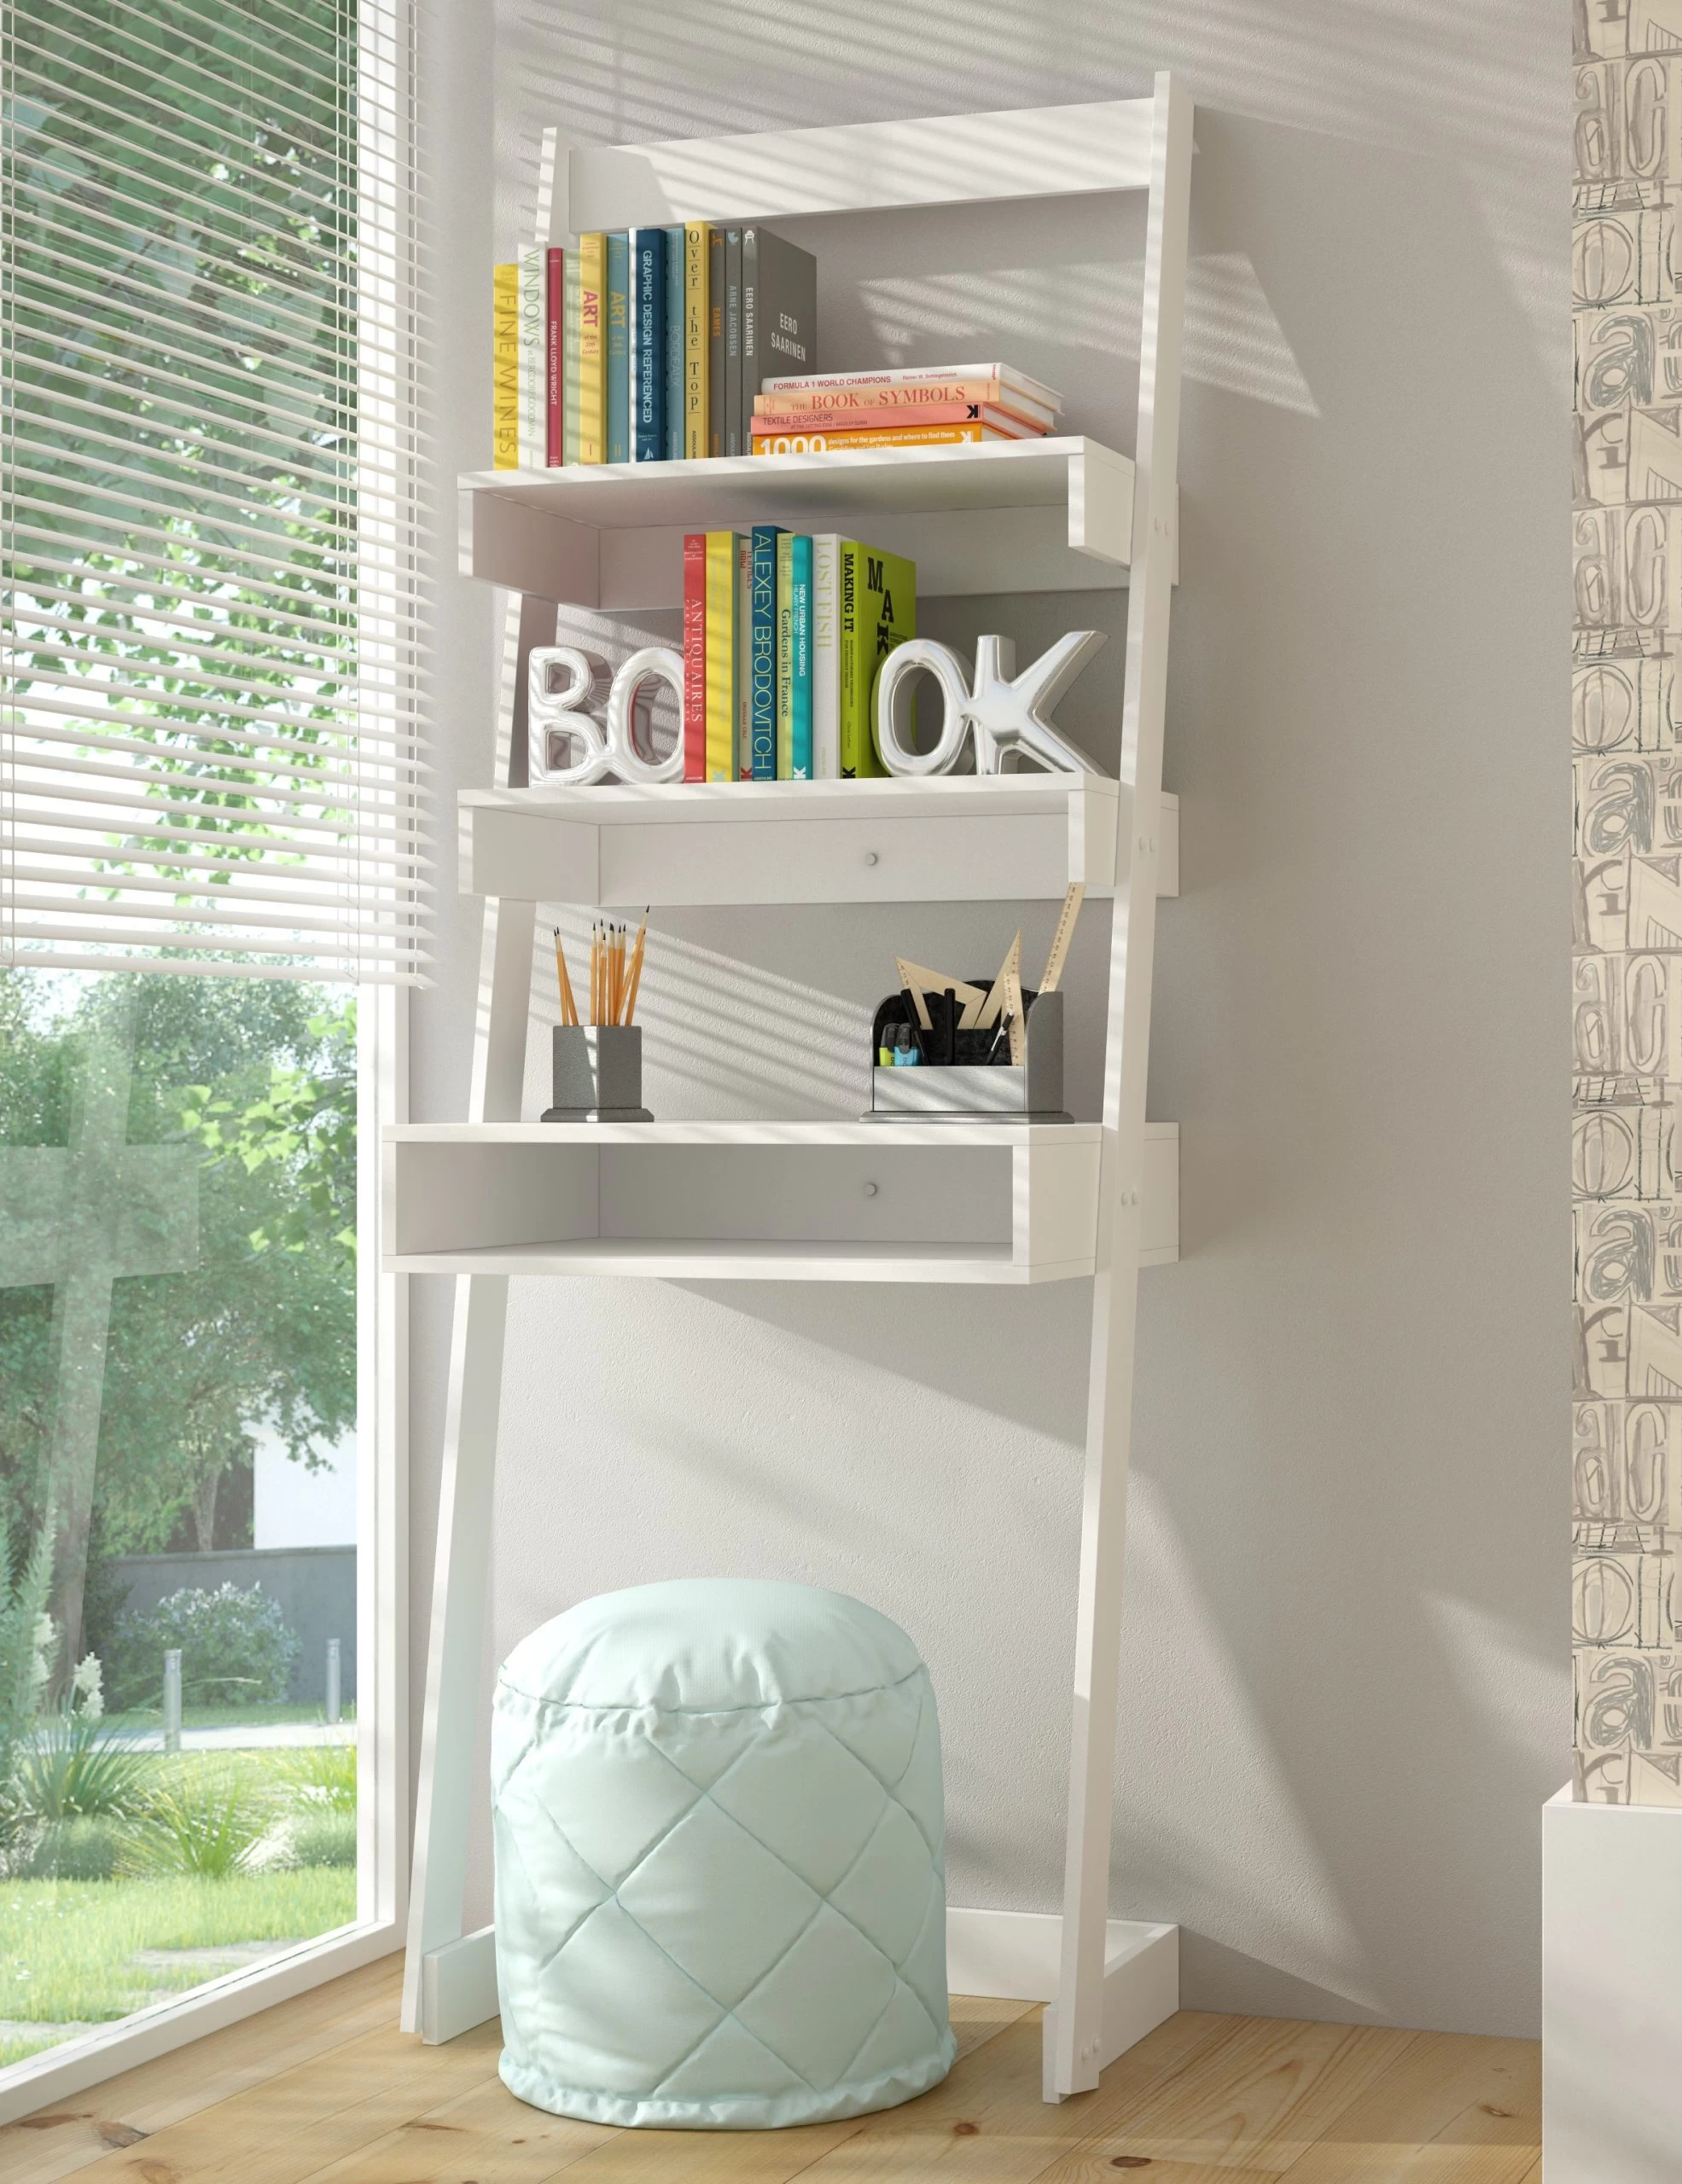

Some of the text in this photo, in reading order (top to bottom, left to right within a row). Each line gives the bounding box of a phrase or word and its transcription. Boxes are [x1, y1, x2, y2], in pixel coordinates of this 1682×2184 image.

[523, 249, 539, 346] WINDOWS
[643, 250, 652, 300] GRAPHIC
[499, 294, 516, 352] FINE
[583, 291, 597, 328] ART
[610, 292, 625, 328] ART
[643, 304, 652, 346] DESIGN
[745, 287, 754, 356] EERO SAARINEN
[779, 312, 797, 335] EERO
[670, 325, 680, 389] BORDEAUX
[771, 333, 806, 363] SAARINEN
[499, 364, 516, 454] WINES
[643, 349, 652, 423] REFERENCED
[773, 380, 810, 391] FORMULA
[818, 378, 844, 387] WORLD
[846, 375, 891, 386] CHAMPIONS
[790, 403, 810, 411] THE
[812, 392, 859, 411] BOOK
[879, 386, 965, 405] SYMBOLS
[760, 434, 827, 456] 1000
[869, 435, 891, 444] gardens
[762, 414, 834, 426] TEXTILE DESIGNERS
[754, 533, 772, 620] ALEXEY
[817, 541, 831, 648] LOST FISH
[844, 553, 853, 633] MAKING IT
[689, 599, 702, 723] ANTIQUAIRES
[781, 608, 791, 717] Gardens in France
[754, 626, 772, 769] BRODOVITCH
